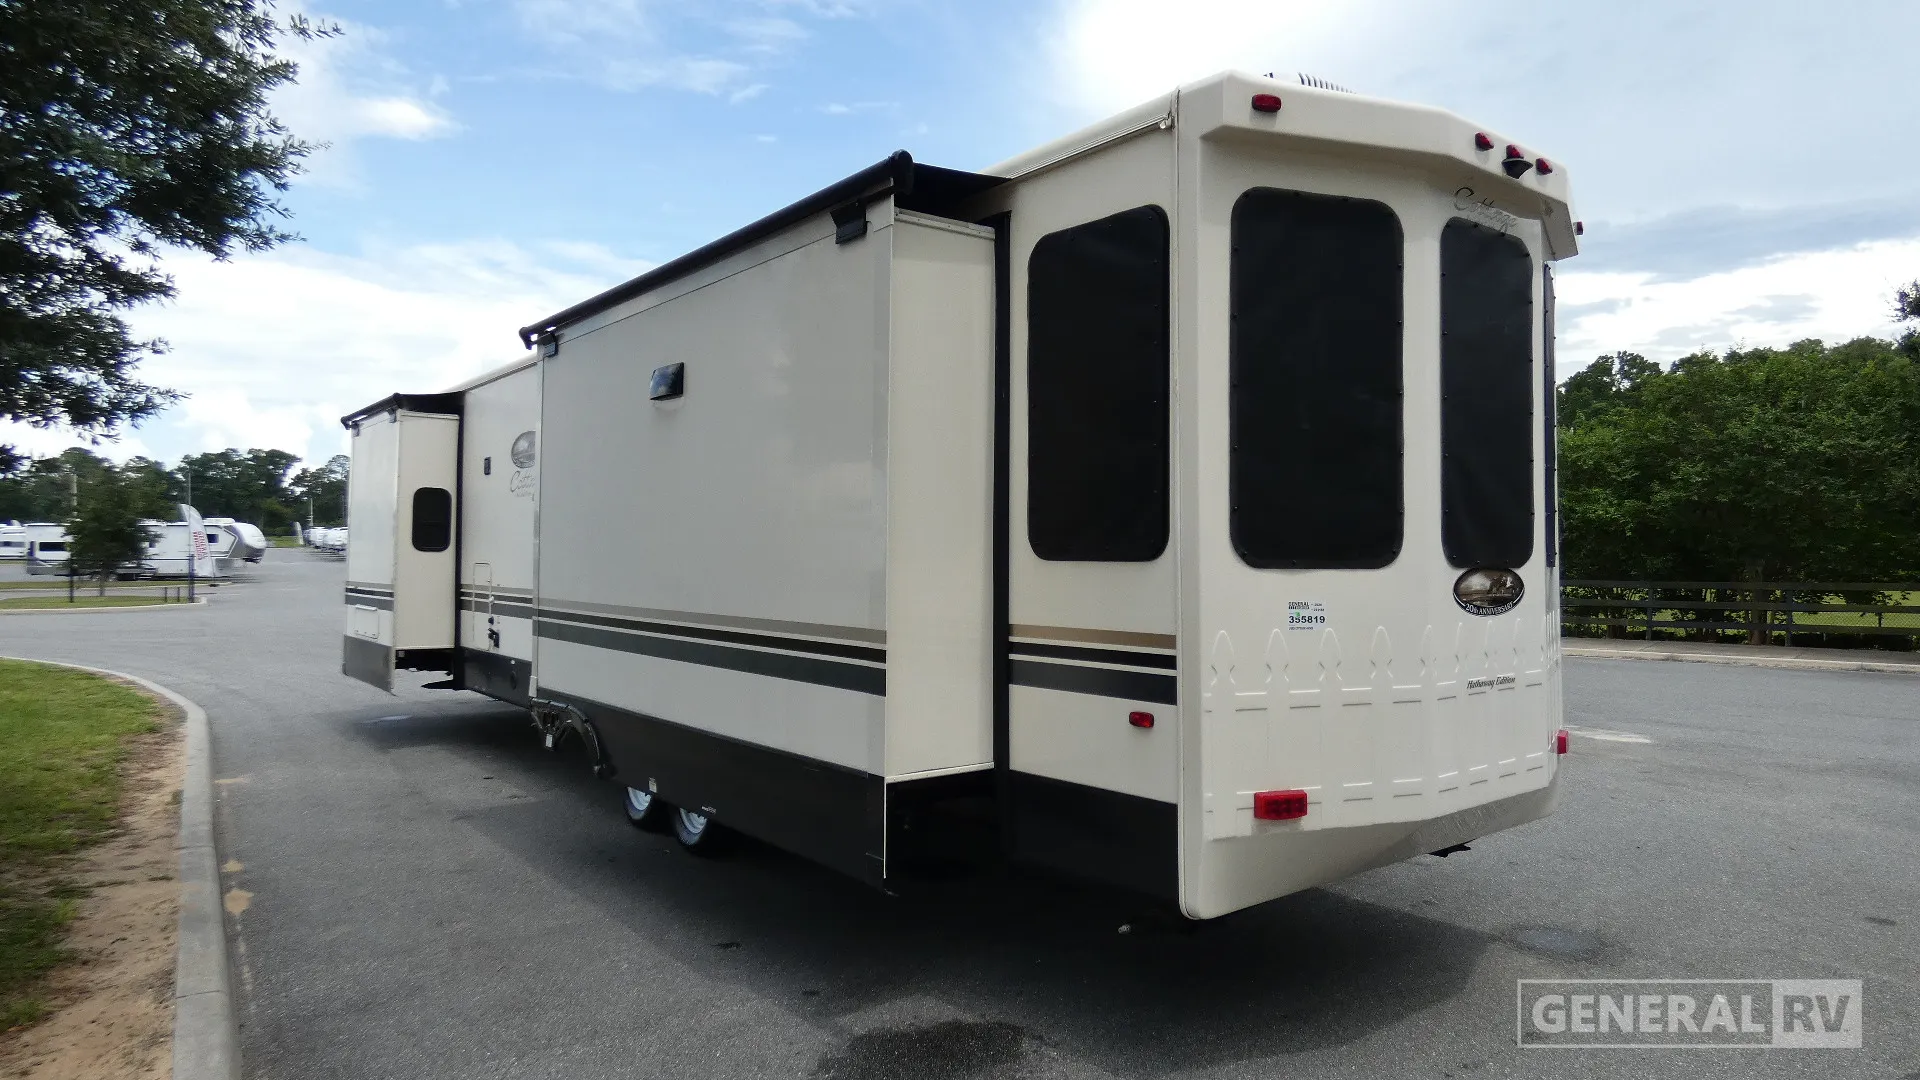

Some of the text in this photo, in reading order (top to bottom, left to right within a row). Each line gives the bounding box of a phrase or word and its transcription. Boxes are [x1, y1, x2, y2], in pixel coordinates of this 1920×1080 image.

[1479, 600, 1514, 615] ANNIVERSARY
[1288, 615, 1326, 624] 355819
[1466, 675, 1516, 690] Hathaway Edition
